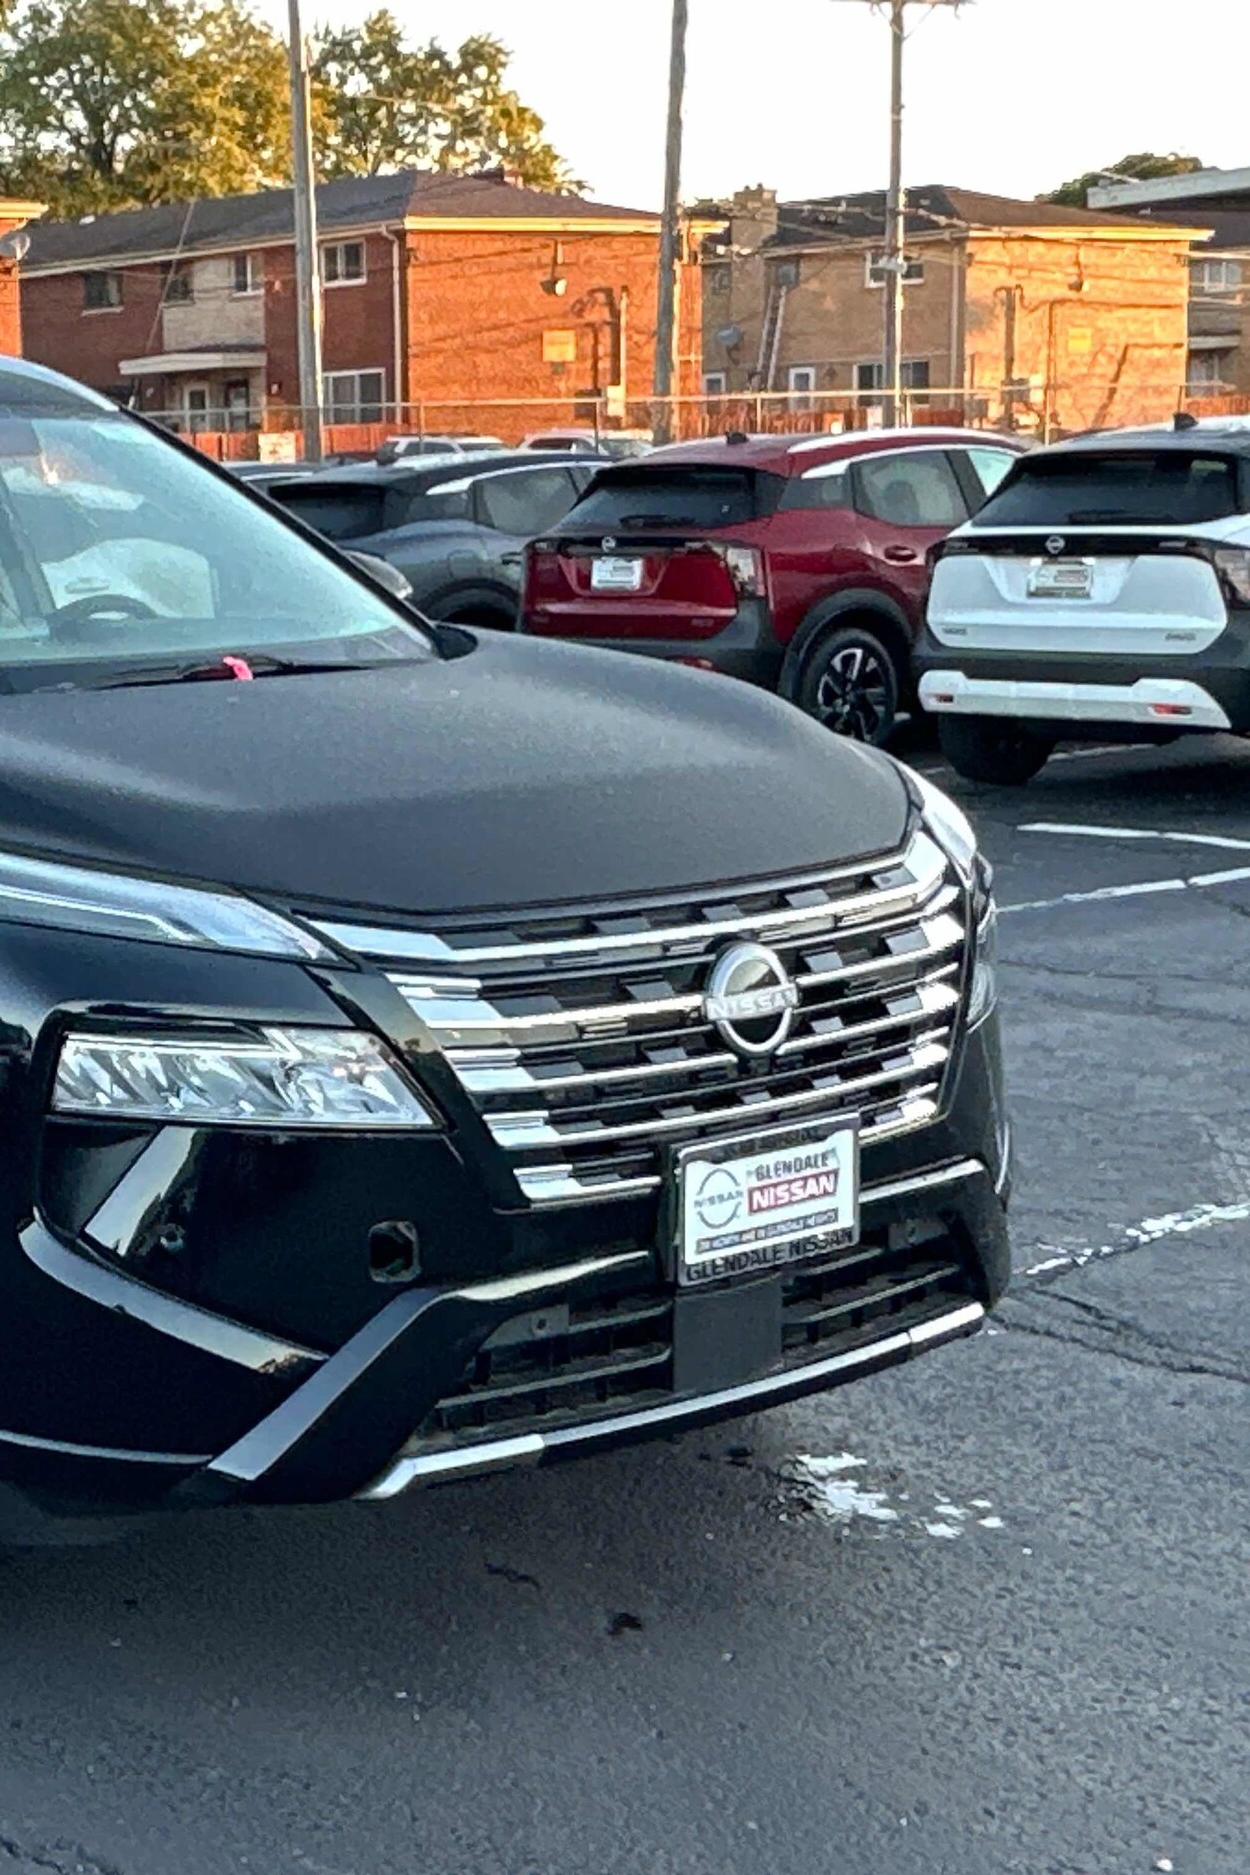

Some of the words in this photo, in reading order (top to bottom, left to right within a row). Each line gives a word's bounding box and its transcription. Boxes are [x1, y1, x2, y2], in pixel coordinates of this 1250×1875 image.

[708, 987, 794, 1018] NISSAN
[755, 1154, 829, 1181] GLENDALE
[694, 1191, 744, 1208] NISSAN
[752, 1175, 835, 1210] NISSAN
[687, 1246, 783, 1281] GLENDALE
[789, 1228, 854, 1258] NISSAN
